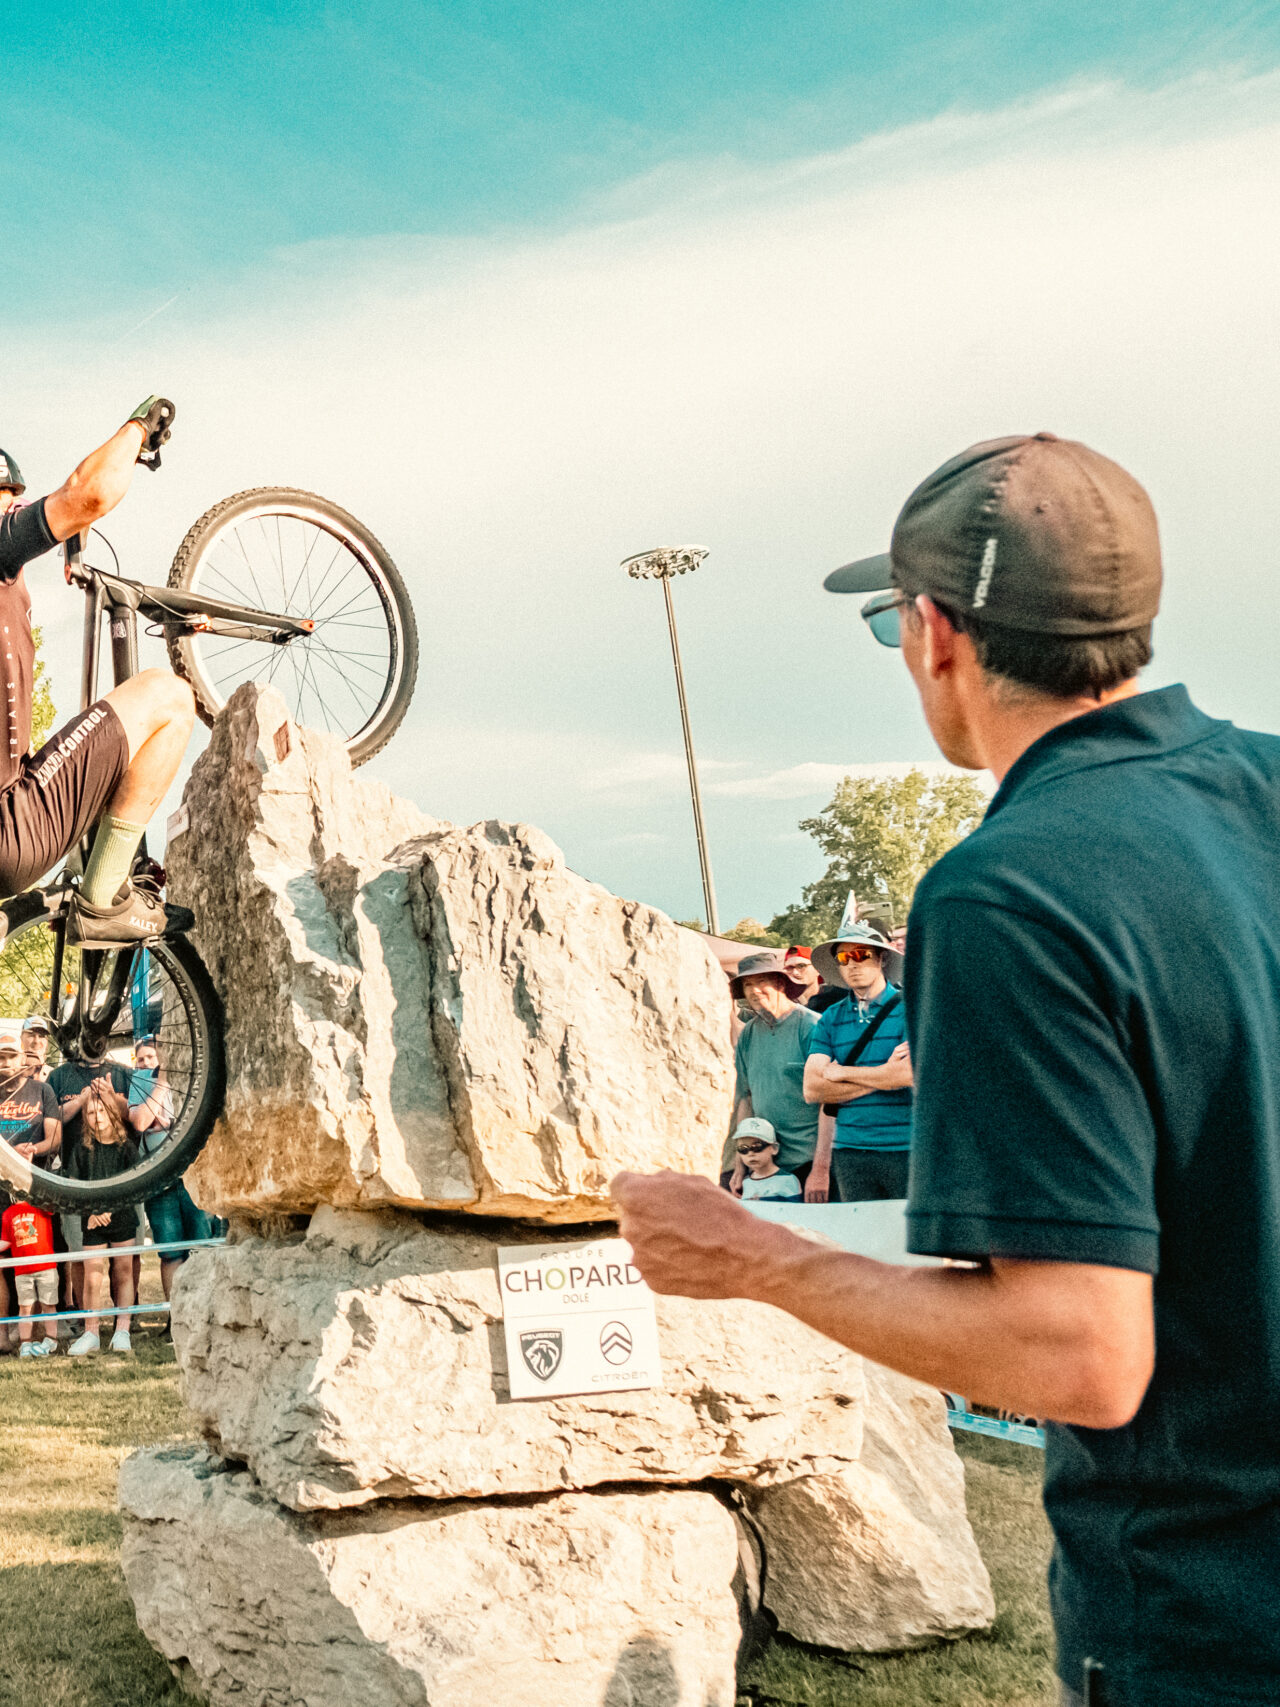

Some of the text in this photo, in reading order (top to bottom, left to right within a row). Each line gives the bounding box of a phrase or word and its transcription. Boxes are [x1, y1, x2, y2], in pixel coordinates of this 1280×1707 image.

[972, 538, 998, 608] VOLCOM
[7, 682, 18, 759] TRIALS
[57, 708, 108, 757] CONTROL
[505, 1263, 643, 1292] CHOPARD
